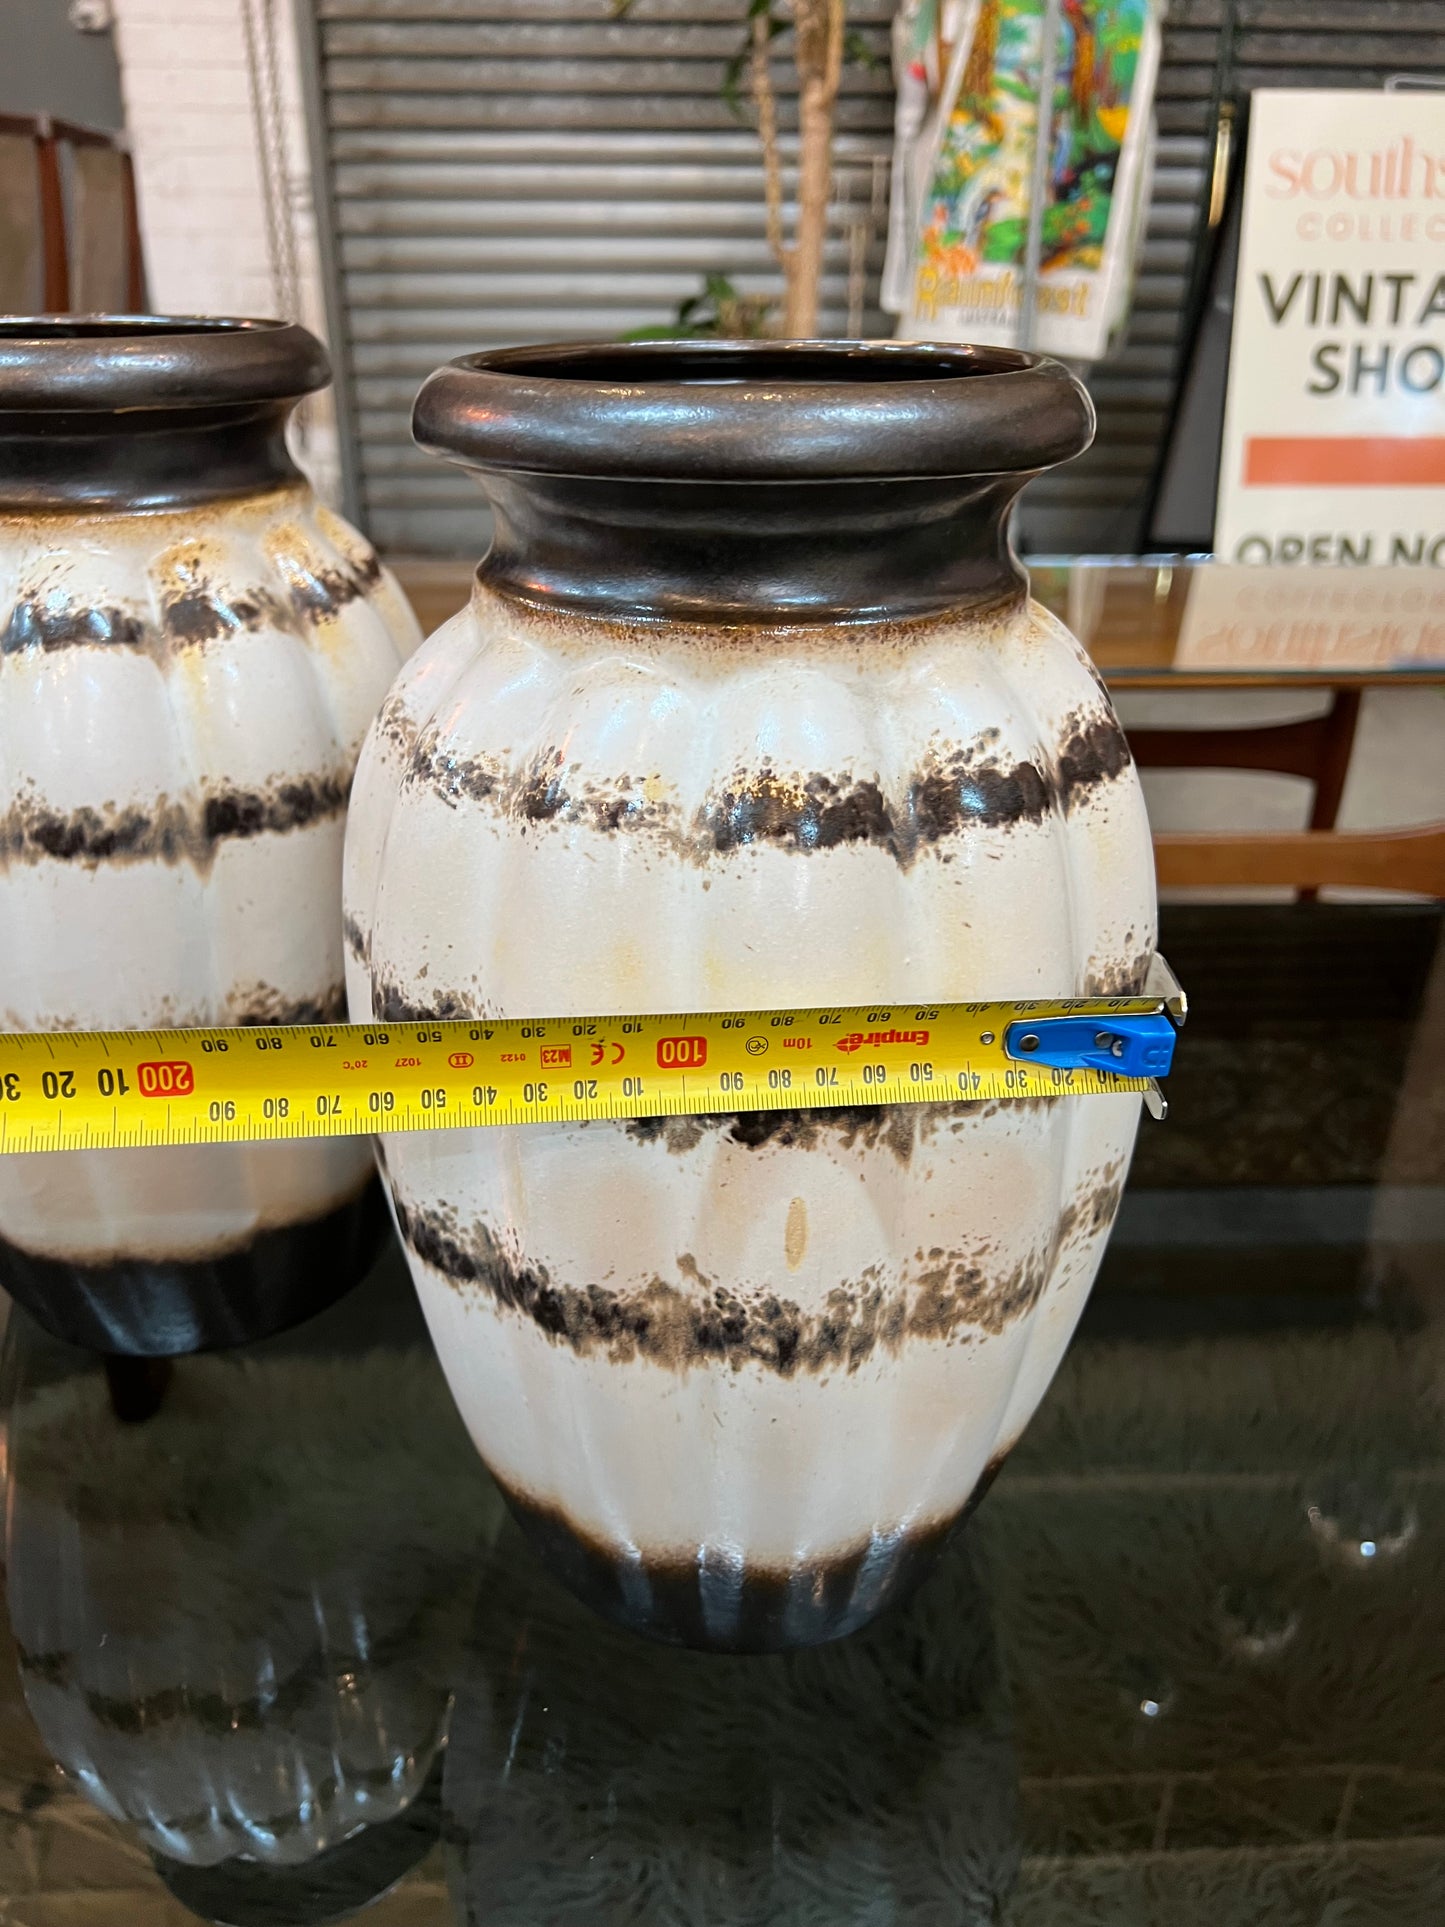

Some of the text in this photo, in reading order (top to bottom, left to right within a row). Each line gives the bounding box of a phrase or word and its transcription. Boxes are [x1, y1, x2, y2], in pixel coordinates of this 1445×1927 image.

[1307, 344, 1445, 394] SHO
[915, 1010, 939, 1020] 50
[966, 1004, 991, 1012] 40
[1014, 1002, 1039, 1010] 30
[722, 1018, 746, 1029] 90
[771, 1016, 795, 1027] 80
[819, 1014, 842, 1024] 70
[867, 1012, 891, 1022] 60
[417, 1031, 442, 1043] 50
[469, 1029, 494, 1041] 40
[521, 1026, 546, 1038] 30
[572, 1024, 597, 1035] 20
[622, 1023, 643, 1033] 10
[201, 1039, 228, 1052] 90
[256, 1037, 283, 1050] 80
[310, 1035, 337, 1048] 70
[364, 1033, 390, 1045] 60
[783, 1038, 813, 1049] 10m
[849, 1029, 929, 1047] Empire
[501, 1053, 526, 1062] 0122
[542, 1049, 570, 1063] M23
[662, 1040, 703, 1063] 100
[395, 1057, 422, 1067] 1027
[142, 1065, 190, 1091] 200
[768, 1069, 791, 1089] 80
[816, 1067, 839, 1086] 70
[863, 1065, 886, 1084] 60
[910, 1063, 933, 1081] 50
[1005, 1070, 1027, 1088] 30
[1052, 1068, 1074, 1086] 20
[0, 1073, 21, 1101] 3
[42, 1070, 76, 1099] 20
[98, 1068, 130, 1096] 10
[574, 1080, 598, 1100] 20
[623, 1077, 644, 1096] 10
[720, 1072, 744, 1091] 90
[958, 1072, 981, 1091] 40
[369, 1091, 394, 1112] 60
[421, 1089, 446, 1109] 50
[472, 1086, 497, 1106] 40
[523, 1083, 548, 1103] 30
[209, 1101, 235, 1121] 90
[263, 1098, 289, 1118] 80
[316, 1095, 342, 1115] 70
